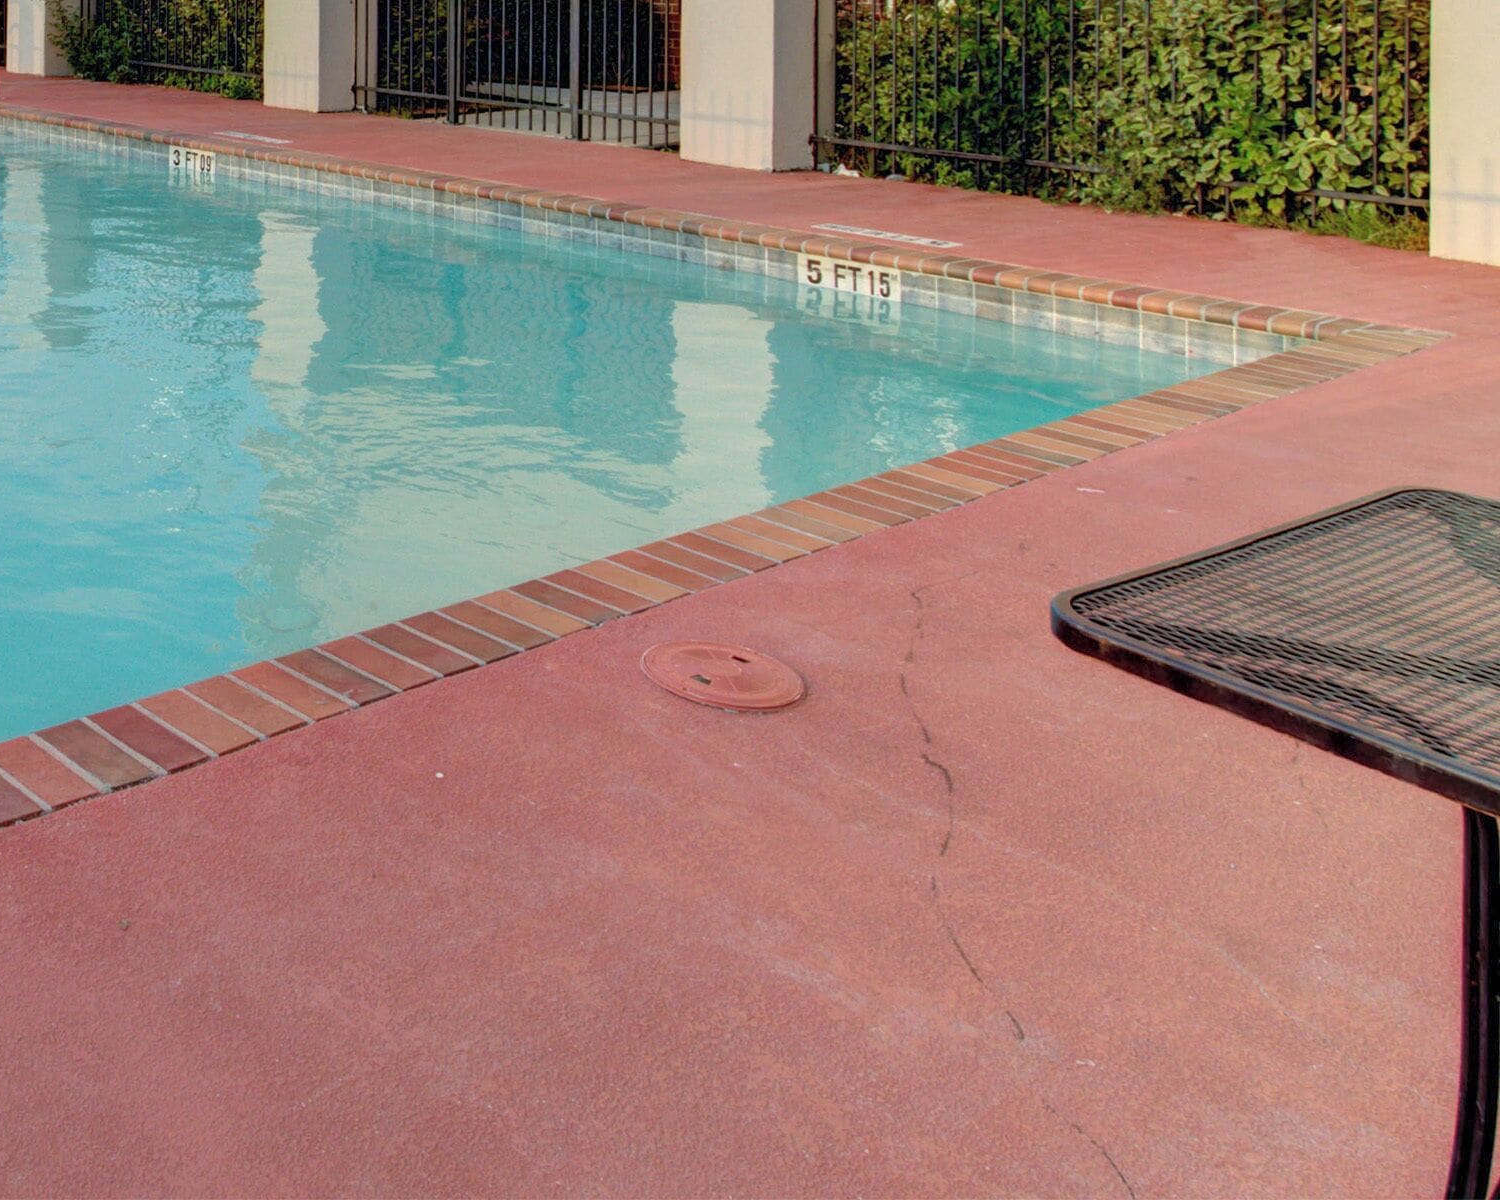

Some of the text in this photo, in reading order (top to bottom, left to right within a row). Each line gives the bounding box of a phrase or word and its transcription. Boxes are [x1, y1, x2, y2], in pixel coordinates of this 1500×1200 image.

[173, 149, 181, 166] 3
[185, 151, 198, 170] FT
[806, 259, 822, 284] 5
[833, 263, 861, 292] FT
